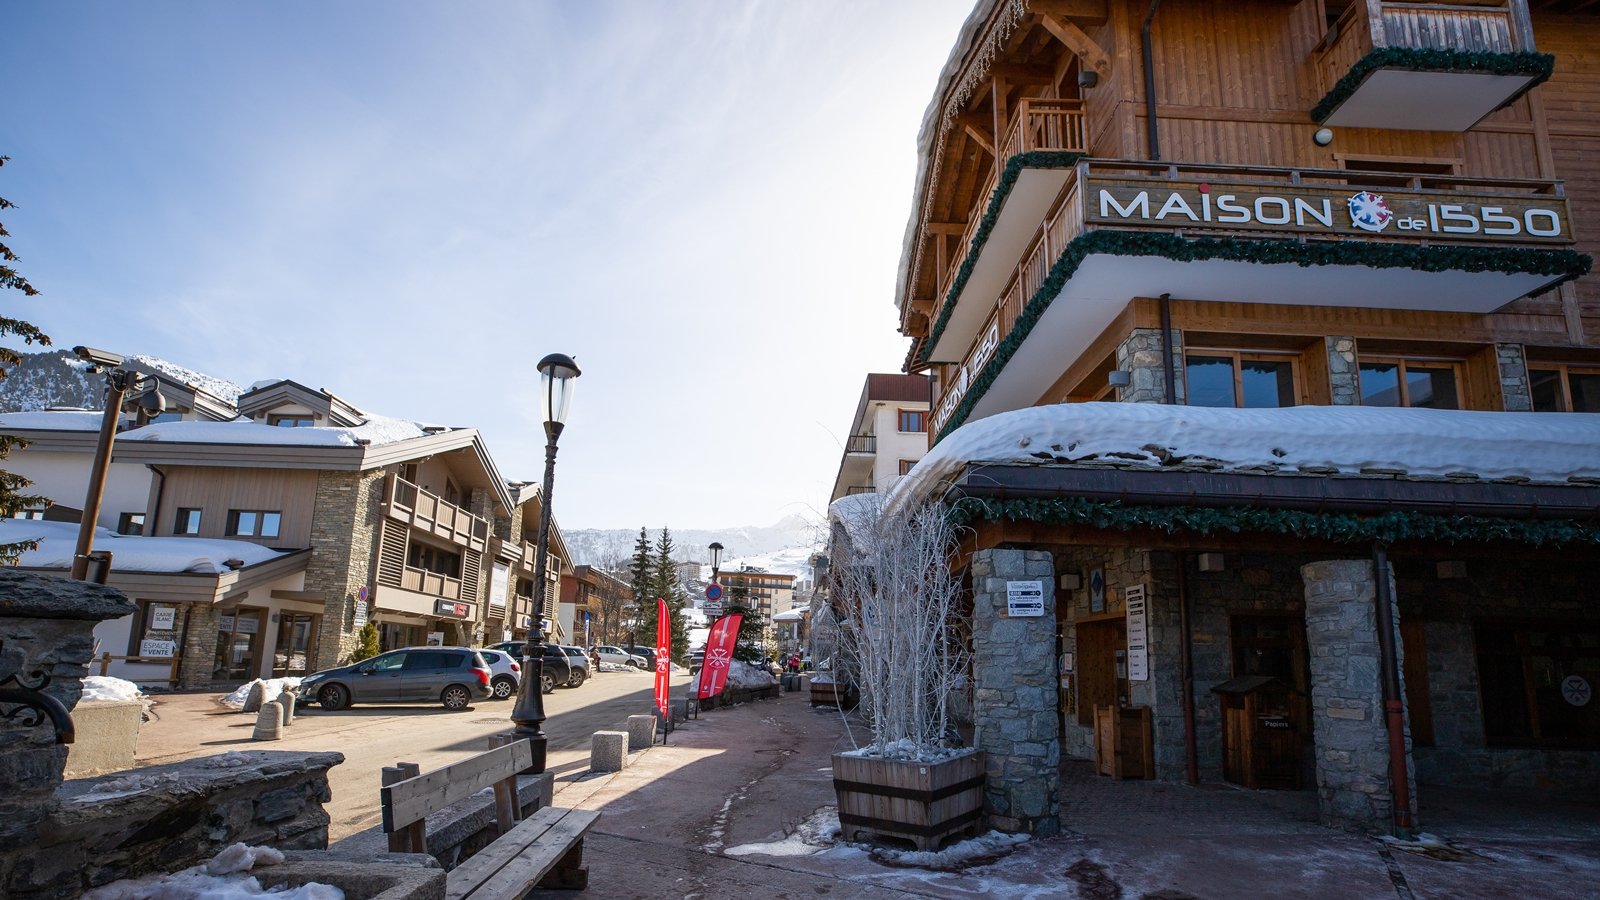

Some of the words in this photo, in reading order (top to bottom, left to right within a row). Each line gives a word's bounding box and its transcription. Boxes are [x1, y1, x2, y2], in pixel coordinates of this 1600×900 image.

[1099, 183, 1333, 227] MAISON
[1397, 216, 1427, 231] de
[1428, 203, 1562, 237] 1550
[143, 642, 170, 650] ESPACE
[1264, 720, 1289, 729] Papiers
